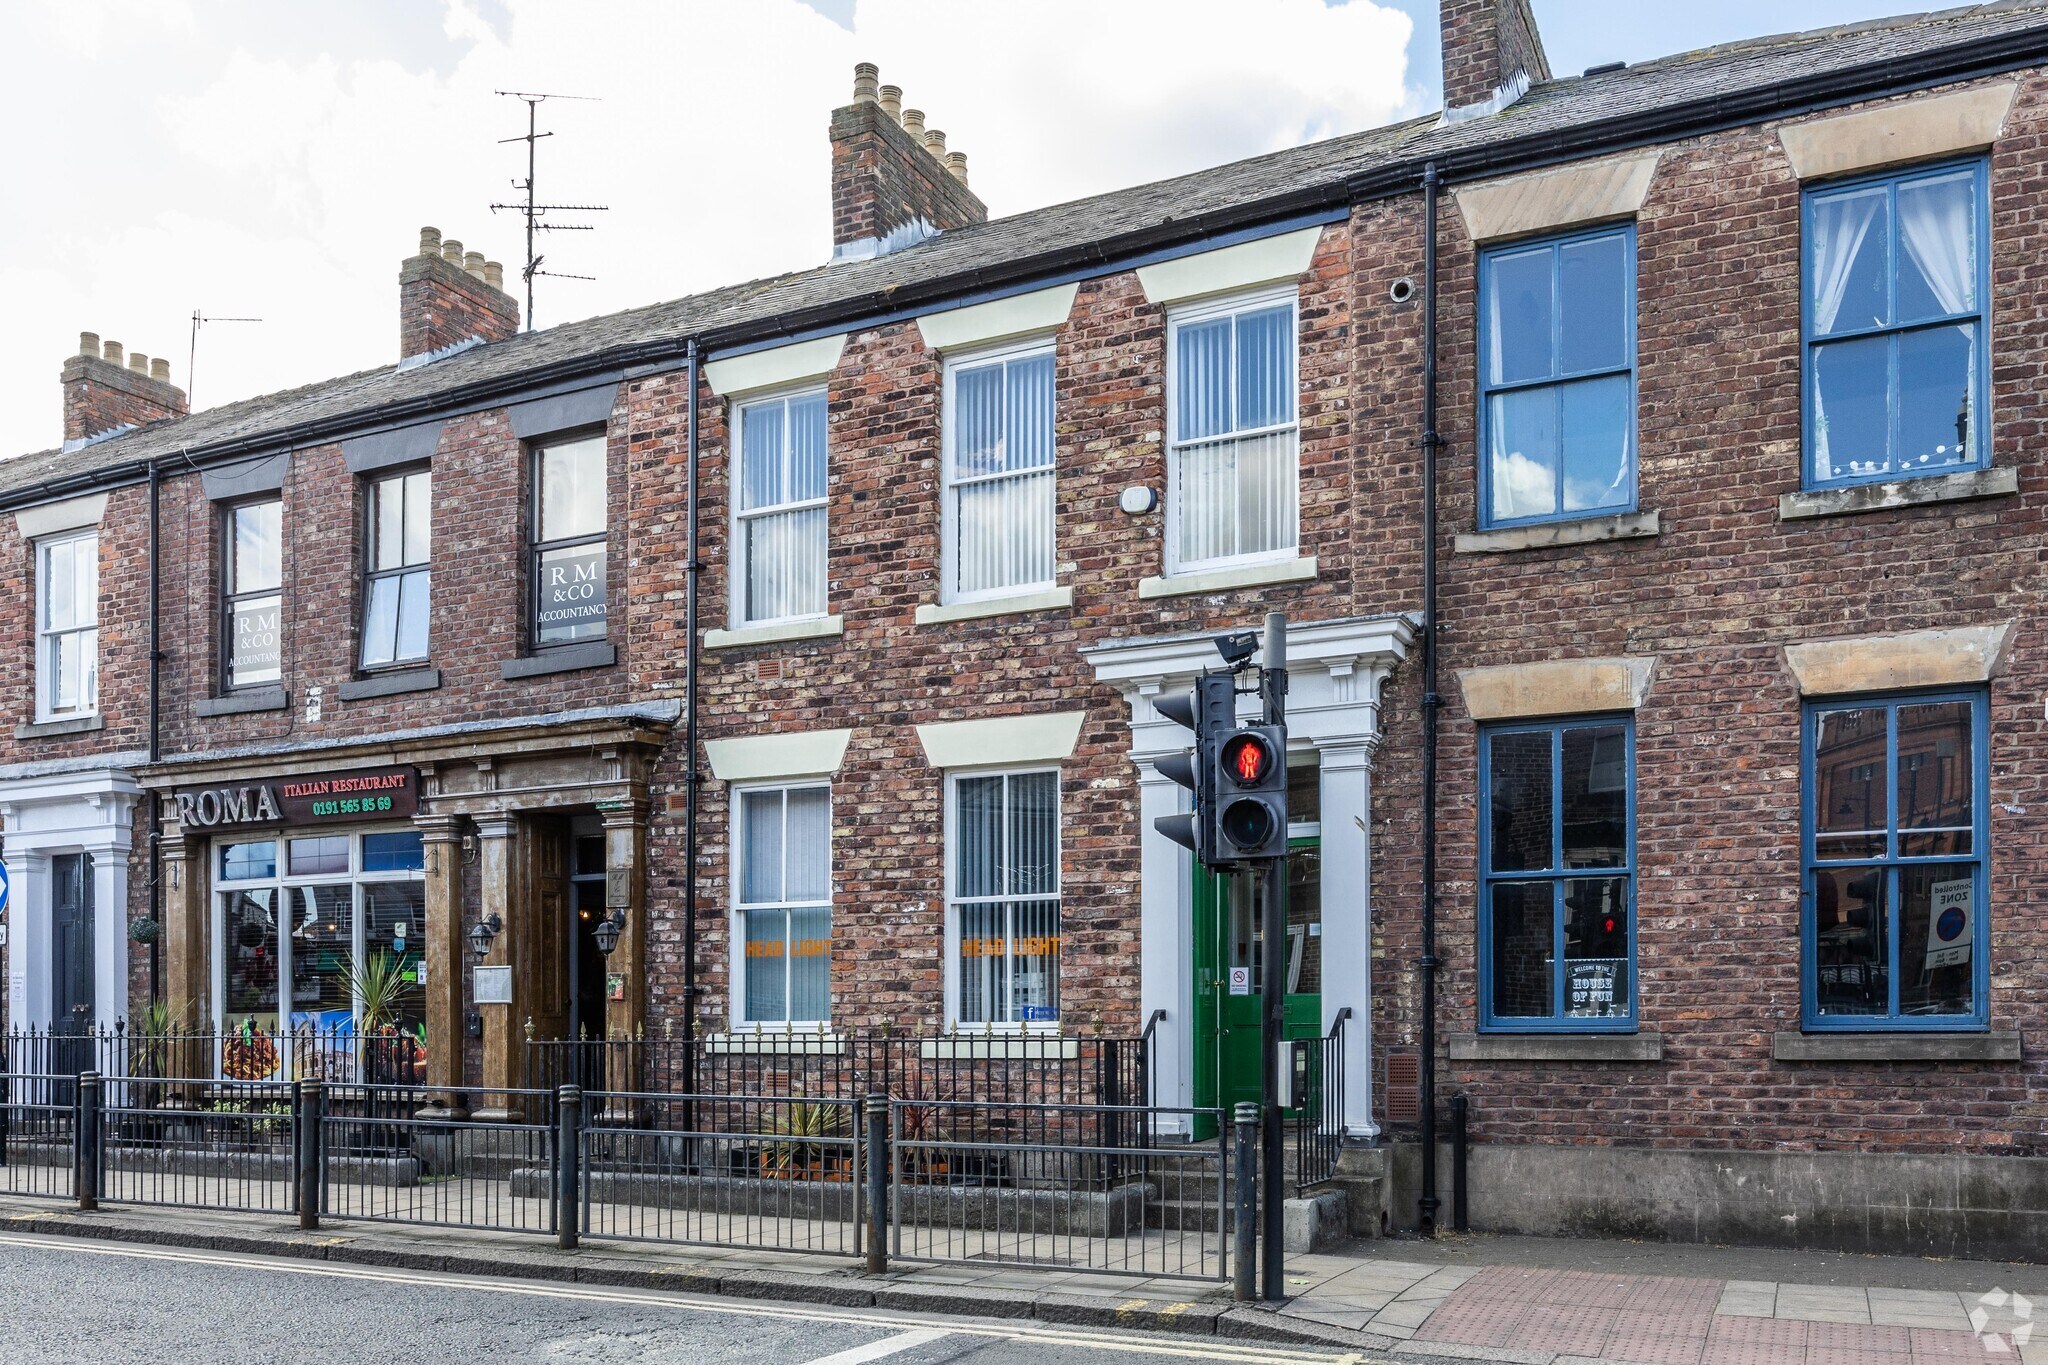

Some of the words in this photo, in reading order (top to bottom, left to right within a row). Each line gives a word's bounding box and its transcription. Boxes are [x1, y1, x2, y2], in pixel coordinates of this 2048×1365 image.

[551, 567, 568, 586] R
[573, 561, 598, 583] M
[239, 617, 252, 634] R
[257, 613, 277, 632] M
[228, 651, 281, 667] ACCOUNTANC
[283, 781, 329, 797] ITALIAN
[332, 774, 405, 793] RESTAURANT
[175, 785, 281, 828] ROMA
[313, 801, 339, 816] 0191
[340, 799, 360, 814] 565
[362, 797, 376, 812] 85
[377, 796, 392, 810] 69
[746, 940, 784, 957] HEAD
[791, 938, 832, 957] LIGHT
[961, 938, 1005, 957] HEAD
[1014, 936, 1060, 956] LIGHT
[1572, 978, 1612, 989] HOUSE
[1572, 991, 1588, 1002] OF
[1589, 991, 1613, 1002] FUN
